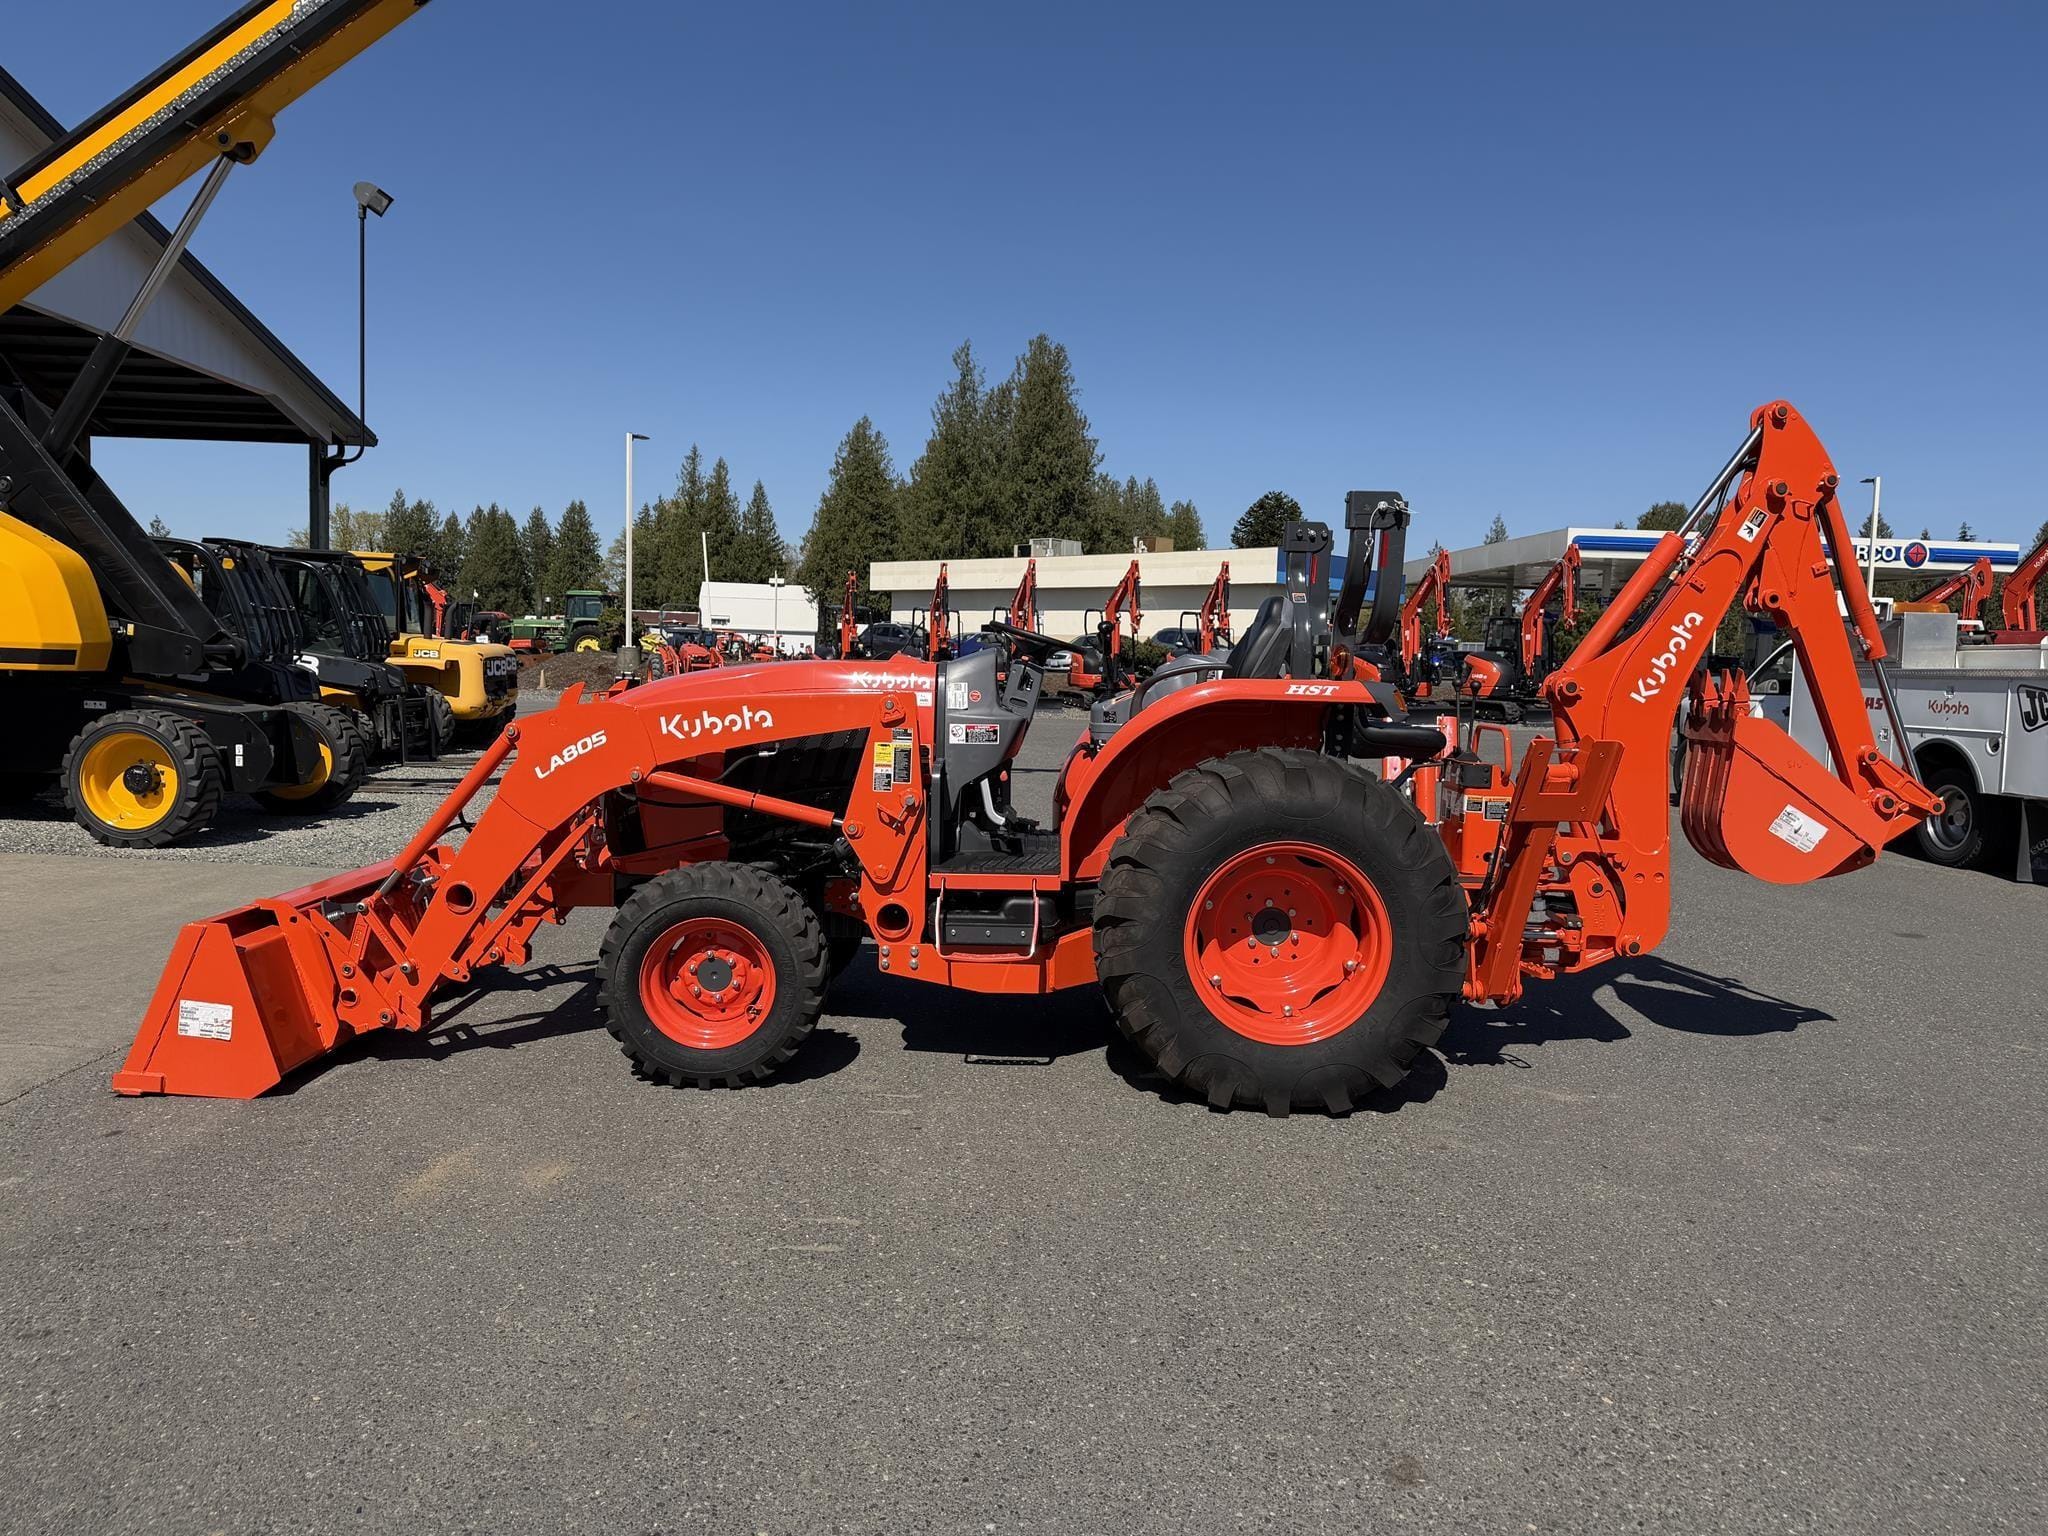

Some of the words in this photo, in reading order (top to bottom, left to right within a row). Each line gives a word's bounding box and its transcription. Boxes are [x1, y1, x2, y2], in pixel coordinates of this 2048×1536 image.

[1855, 545, 1896, 561] RCO
[413, 650, 439, 658] JCB
[1629, 612, 1704, 704] Kubota
[486, 660, 507, 676] JCB
[506, 656, 517, 671] CB
[852, 671, 931, 689] Kubota
[1284, 684, 1340, 696] HST
[1928, 699, 1969, 715] Kubota
[2024, 689, 2048, 727] JC
[660, 704, 774, 739] Kubota
[534, 730, 608, 779] LA805
